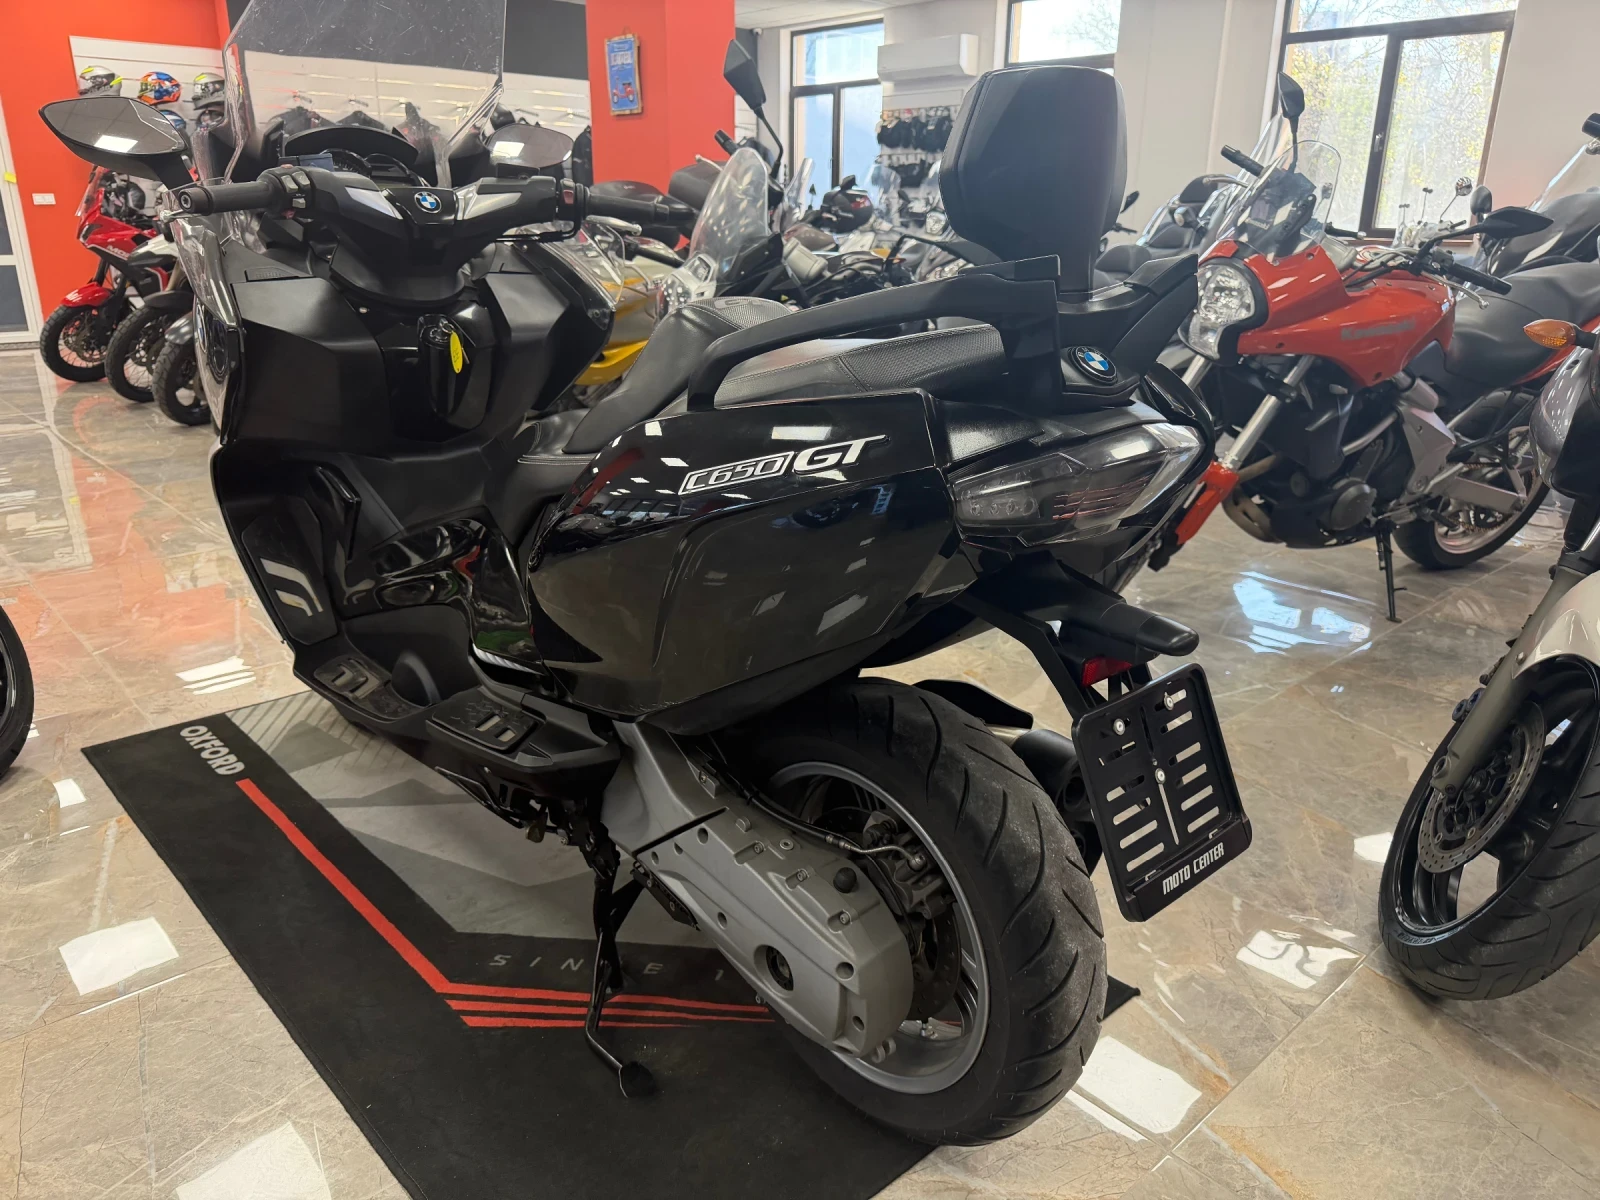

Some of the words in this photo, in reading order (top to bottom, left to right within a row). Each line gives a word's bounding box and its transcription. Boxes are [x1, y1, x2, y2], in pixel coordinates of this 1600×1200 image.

[685, 456, 786, 491] C650
[793, 434, 887, 473] GT
[180, 725, 245, 776] OXFORD
[1162, 864, 1191, 896] MOTO
[1193, 841, 1225, 875] CENTER
[489, 954, 664, 975] SINE
